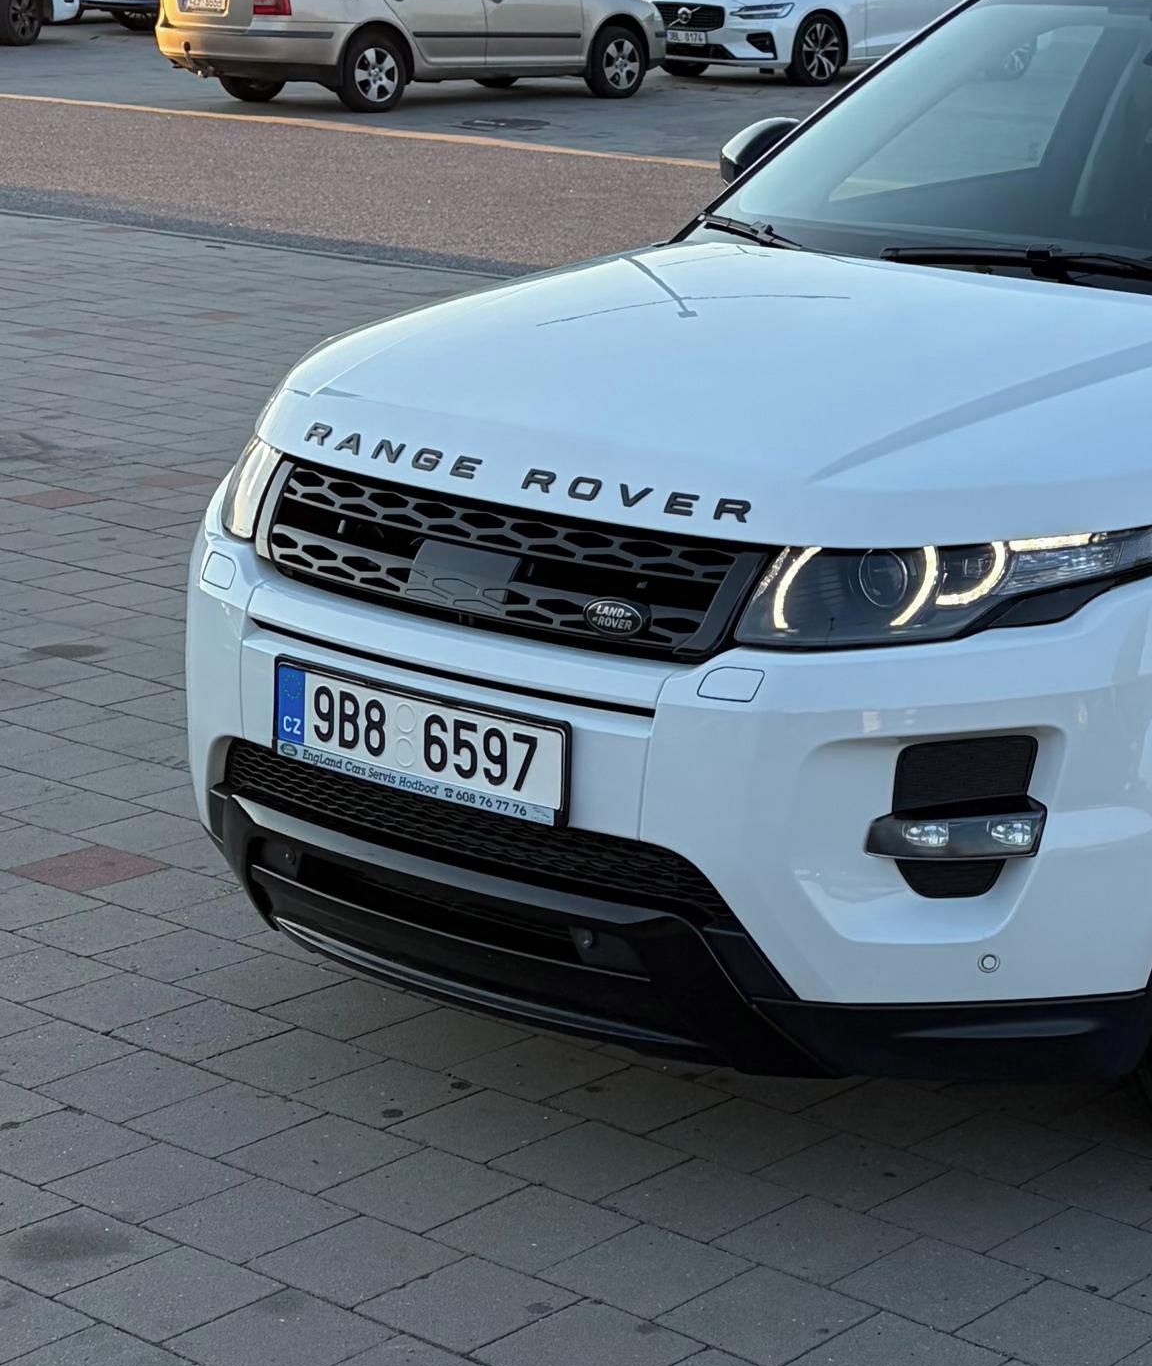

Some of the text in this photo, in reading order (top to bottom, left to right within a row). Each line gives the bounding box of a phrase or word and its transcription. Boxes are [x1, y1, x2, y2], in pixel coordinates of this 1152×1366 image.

[303, 422, 752, 524] RANGE ROVER
[596, 605, 624, 618] LAND
[597, 616, 633, 631] ROVER
[282, 715, 301, 735] CZ
[313, 685, 538, 792] 9B8 6597
[345, 761, 366, 776] Cars
[368, 767, 396, 784] Servis
[455, 790, 476, 804] 608
[479, 795, 493, 808] 76
[495, 799, 509, 812] 77
[513, 803, 527, 817] 76
